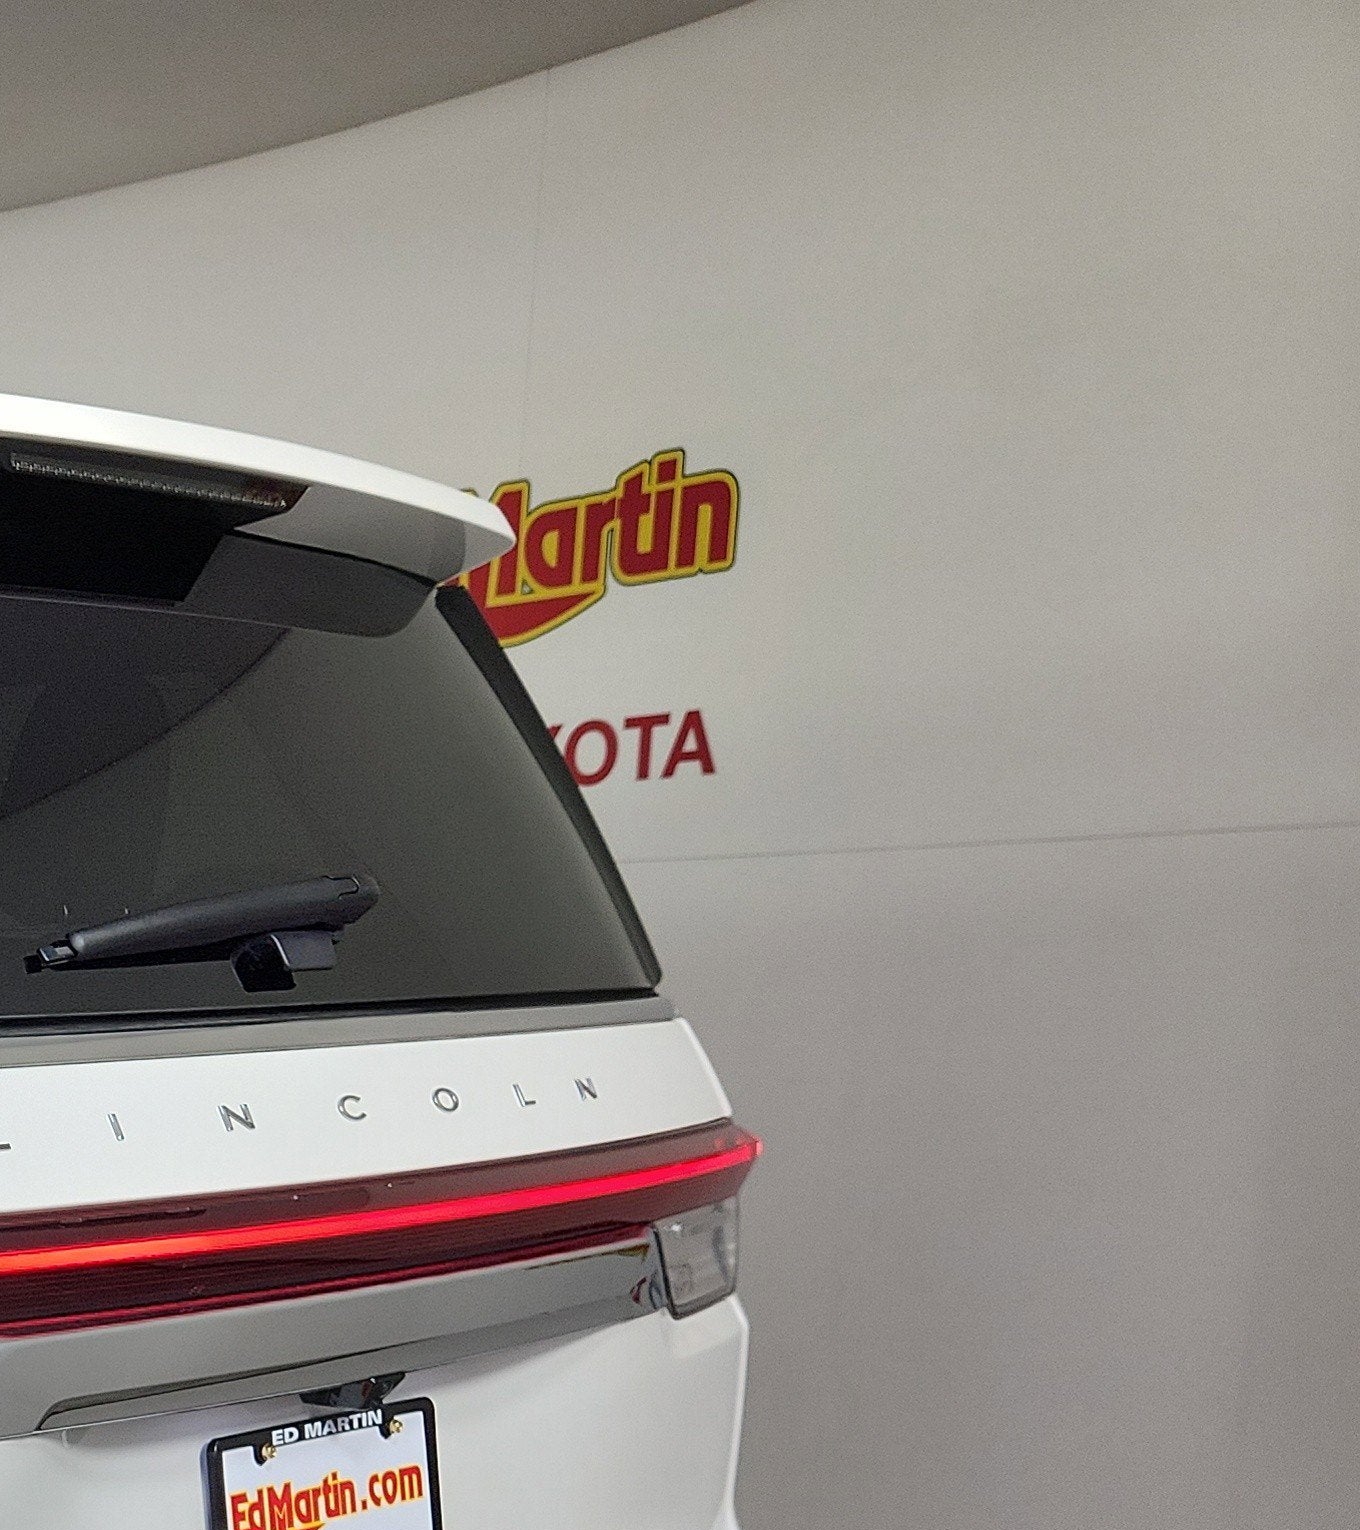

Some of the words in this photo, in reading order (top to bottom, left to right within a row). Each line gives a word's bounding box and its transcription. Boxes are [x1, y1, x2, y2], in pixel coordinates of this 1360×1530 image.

[546, 709, 717, 788] OTA
[270, 1427, 299, 1447] ED
[303, 1408, 383, 1440] MARTIN
